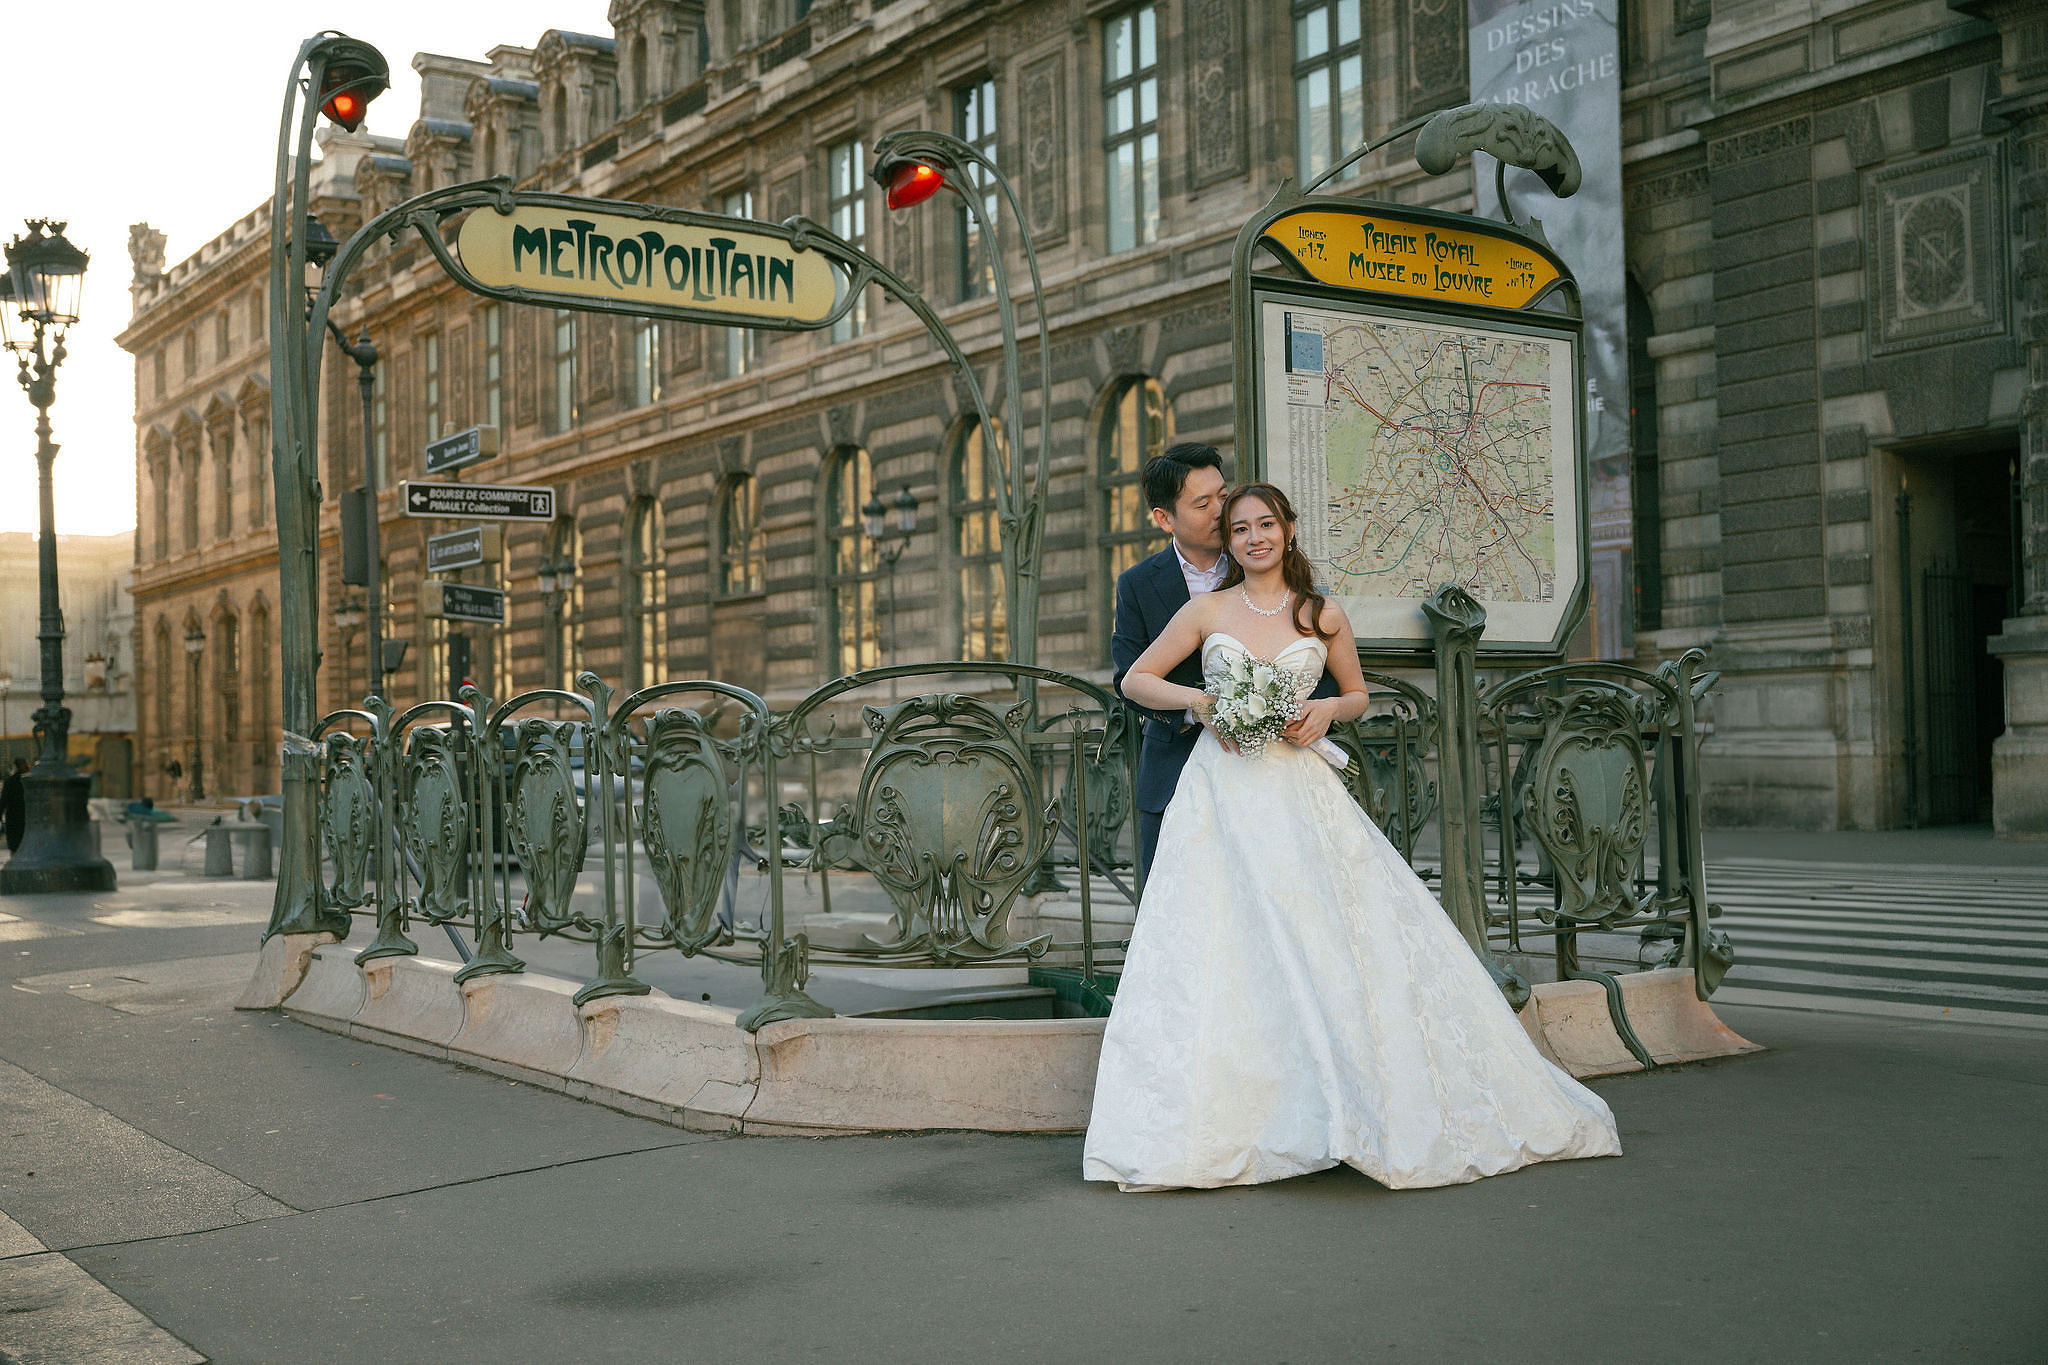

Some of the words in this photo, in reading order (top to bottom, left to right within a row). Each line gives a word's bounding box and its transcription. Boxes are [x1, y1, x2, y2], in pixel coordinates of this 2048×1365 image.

[1488, 0, 1593, 52] DESSINS
[1479, 53, 1615, 105] RRACHE
[1516, 38, 1565, 74] DES
[512, 219, 794, 304] METROPOLITAIN
[1360, 222, 1417, 254] PALAIS
[1424, 232, 1480, 267] ROYAL
[1348, 251, 1406, 283] MUSÉE
[1412, 272, 1427, 286] DU
[1433, 264, 1493, 298] LOUVRE
[429, 488, 465, 500] BOURSE
[466, 489, 479, 500] DE
[479, 490, 529, 502] COMMERCE
[429, 500, 467, 511] PINAULT
[467, 502, 510, 513] Collection
